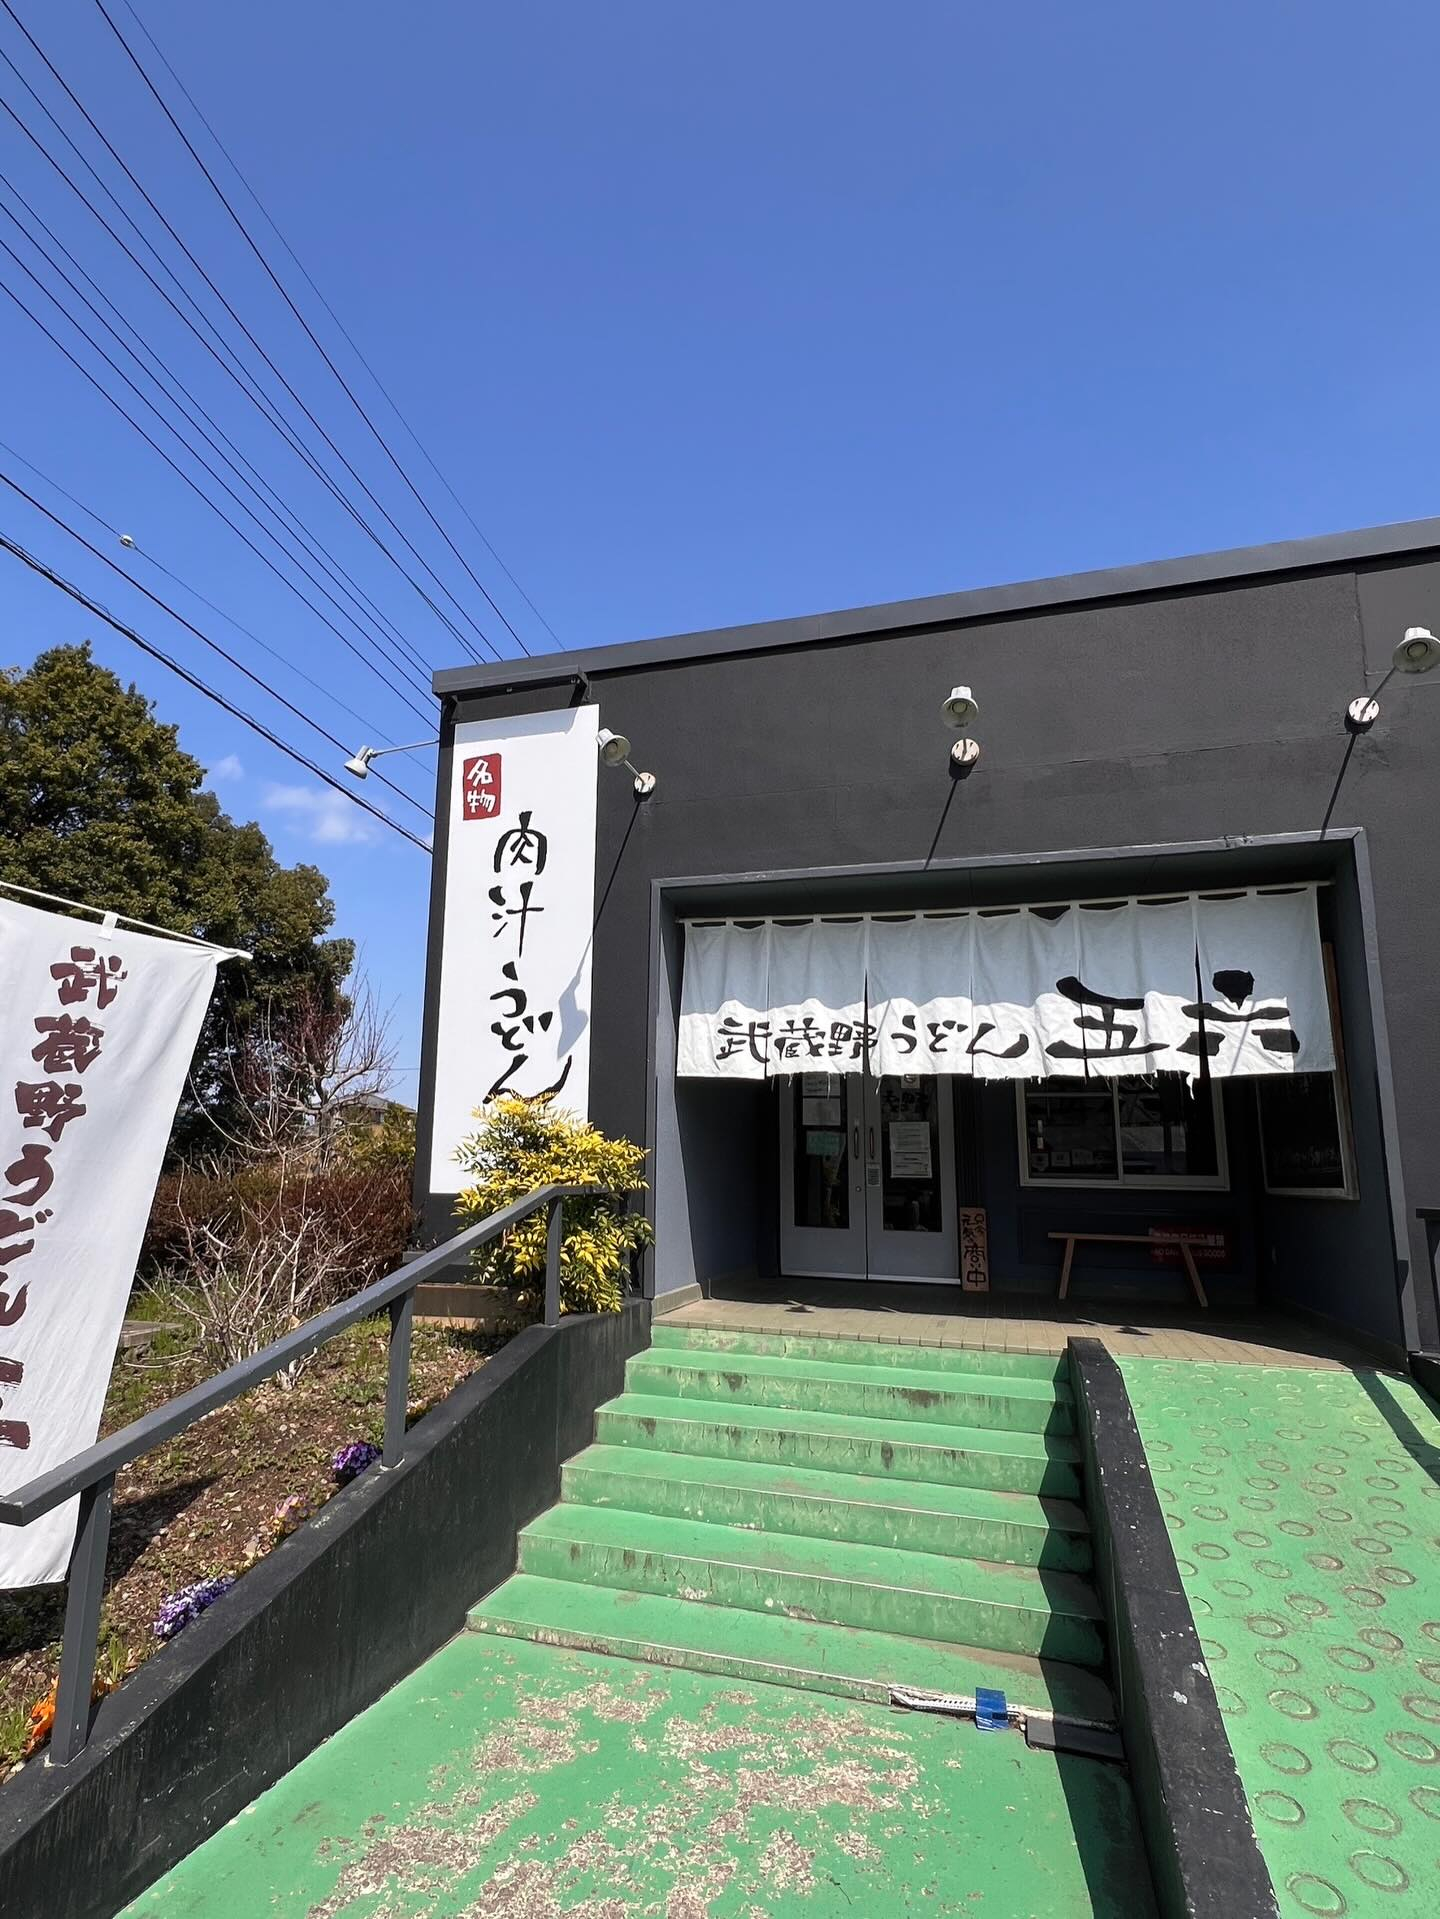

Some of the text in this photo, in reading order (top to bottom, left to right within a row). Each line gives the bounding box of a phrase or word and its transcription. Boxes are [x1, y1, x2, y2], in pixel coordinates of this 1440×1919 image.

[467, 757, 496, 814] 名物
[482, 811, 572, 1106] 肉汁うどん
[716, 970, 1300, 1063] 武蔵野うどん 五六
